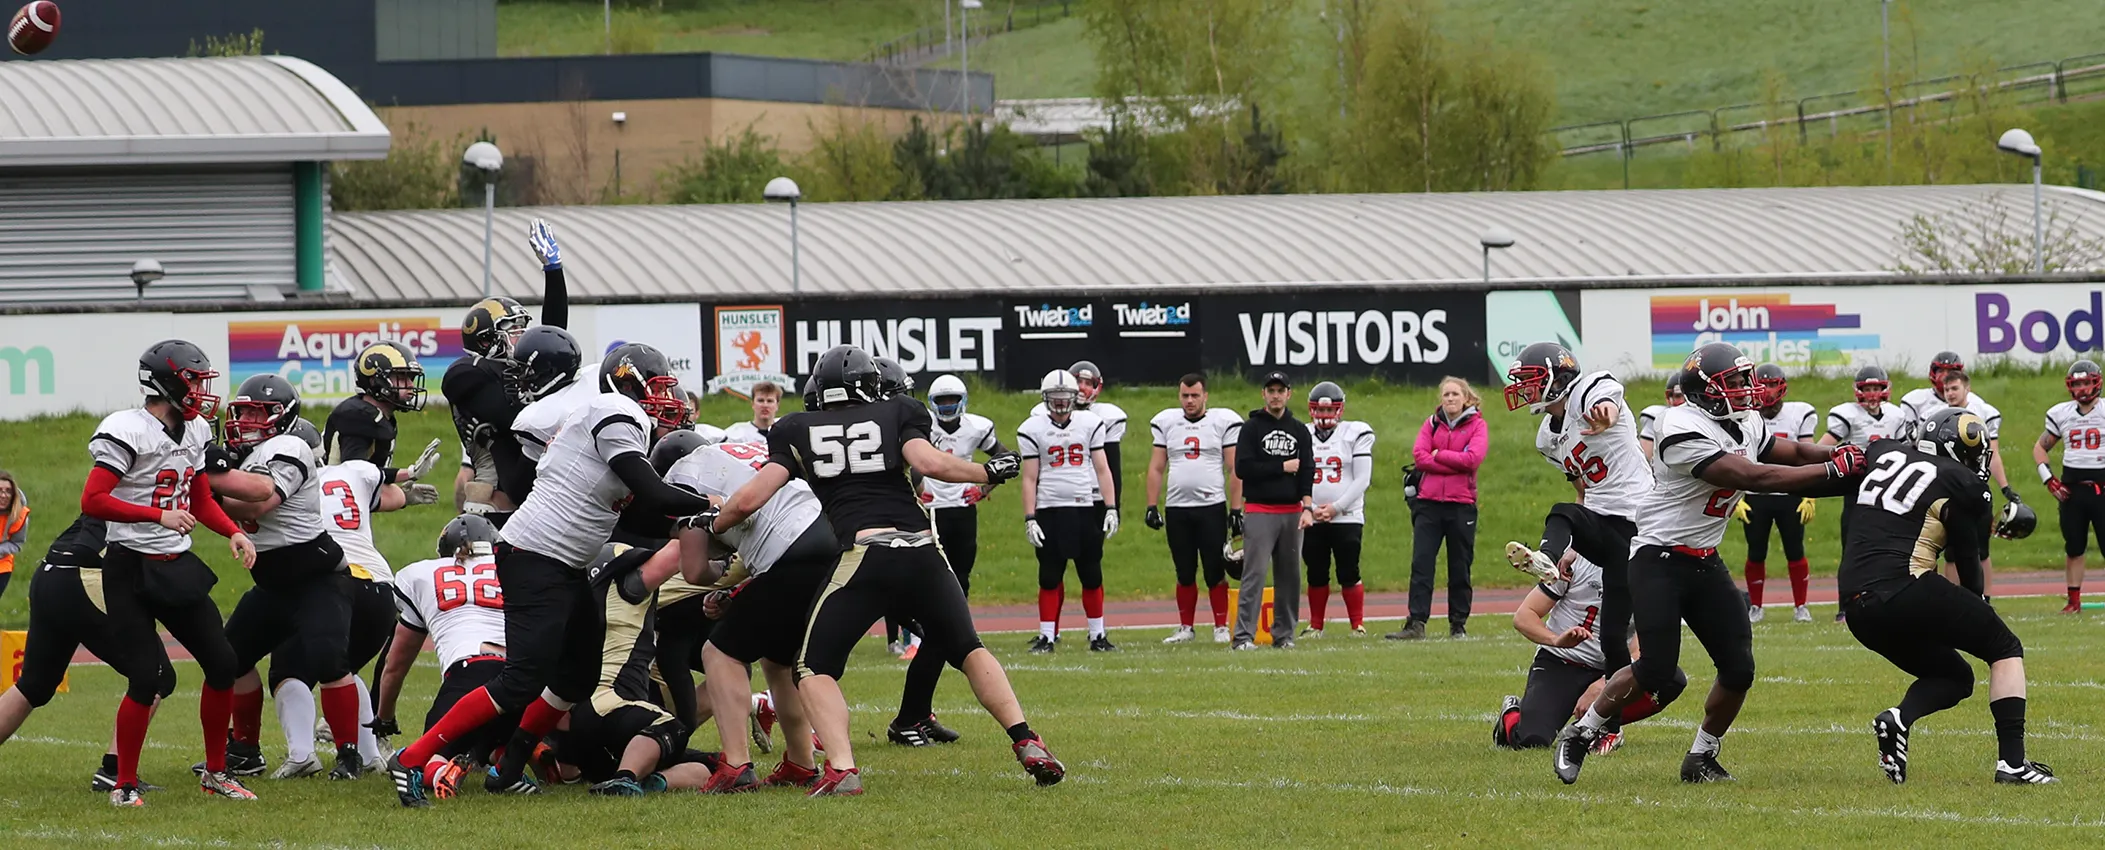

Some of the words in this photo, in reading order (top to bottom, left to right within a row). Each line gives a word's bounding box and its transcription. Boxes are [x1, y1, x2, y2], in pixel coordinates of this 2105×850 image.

[722, 313, 777, 325] HUNSLET
[1014, 303, 1092, 328] Twisted
[1113, 301, 1190, 326] Twisted
[1693, 298, 1770, 331] John
[277, 322, 438, 367] Aquatics
[796, 317, 1003, 375] HUNSLET
[1238, 309, 1449, 365] VISITORS
[808, 420, 886, 478] 52
[1047, 443, 1084, 468] 36
[1184, 436, 1200, 460] 3
[321, 479, 361, 531] 3
[1856, 450, 1938, 515] 20
[433, 563, 505, 612] 62
